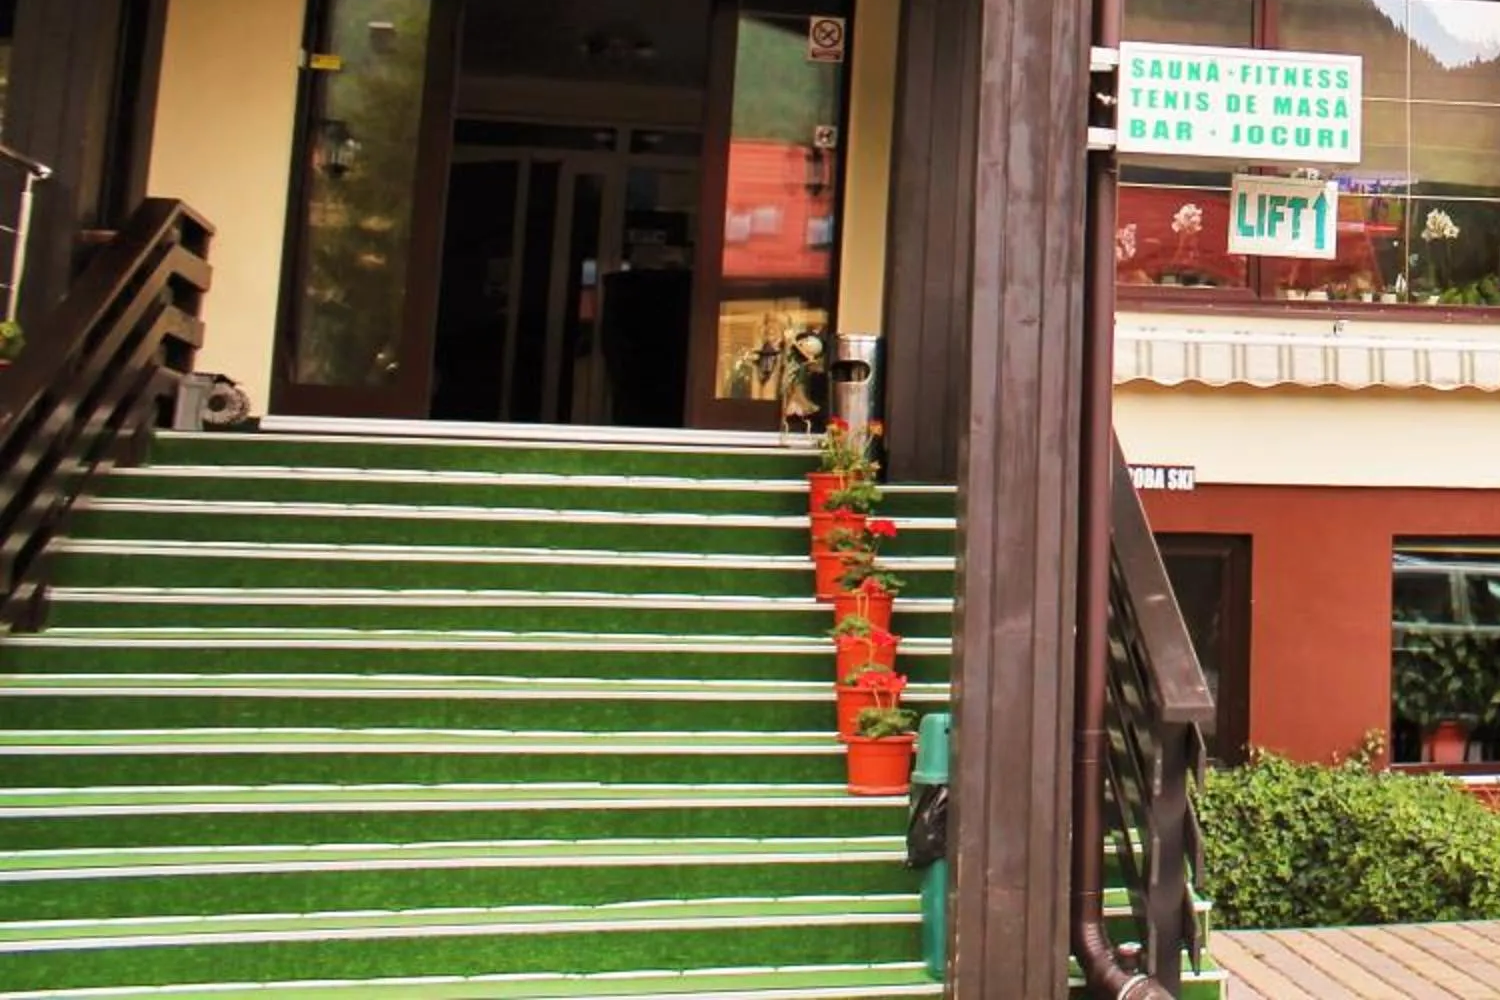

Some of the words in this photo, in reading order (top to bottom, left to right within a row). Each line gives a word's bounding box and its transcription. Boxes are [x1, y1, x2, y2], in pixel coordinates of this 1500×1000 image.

[1240, 65, 1349, 89] FITNESS
[1131, 87, 1210, 111] TENIS
[1226, 94, 1258, 114] DE
[1130, 119, 1192, 140] BAR
[1231, 126, 1348, 148] JOCURI
[1236, 192, 1309, 240] LIFT
[1167, 468, 1194, 490] SKI
